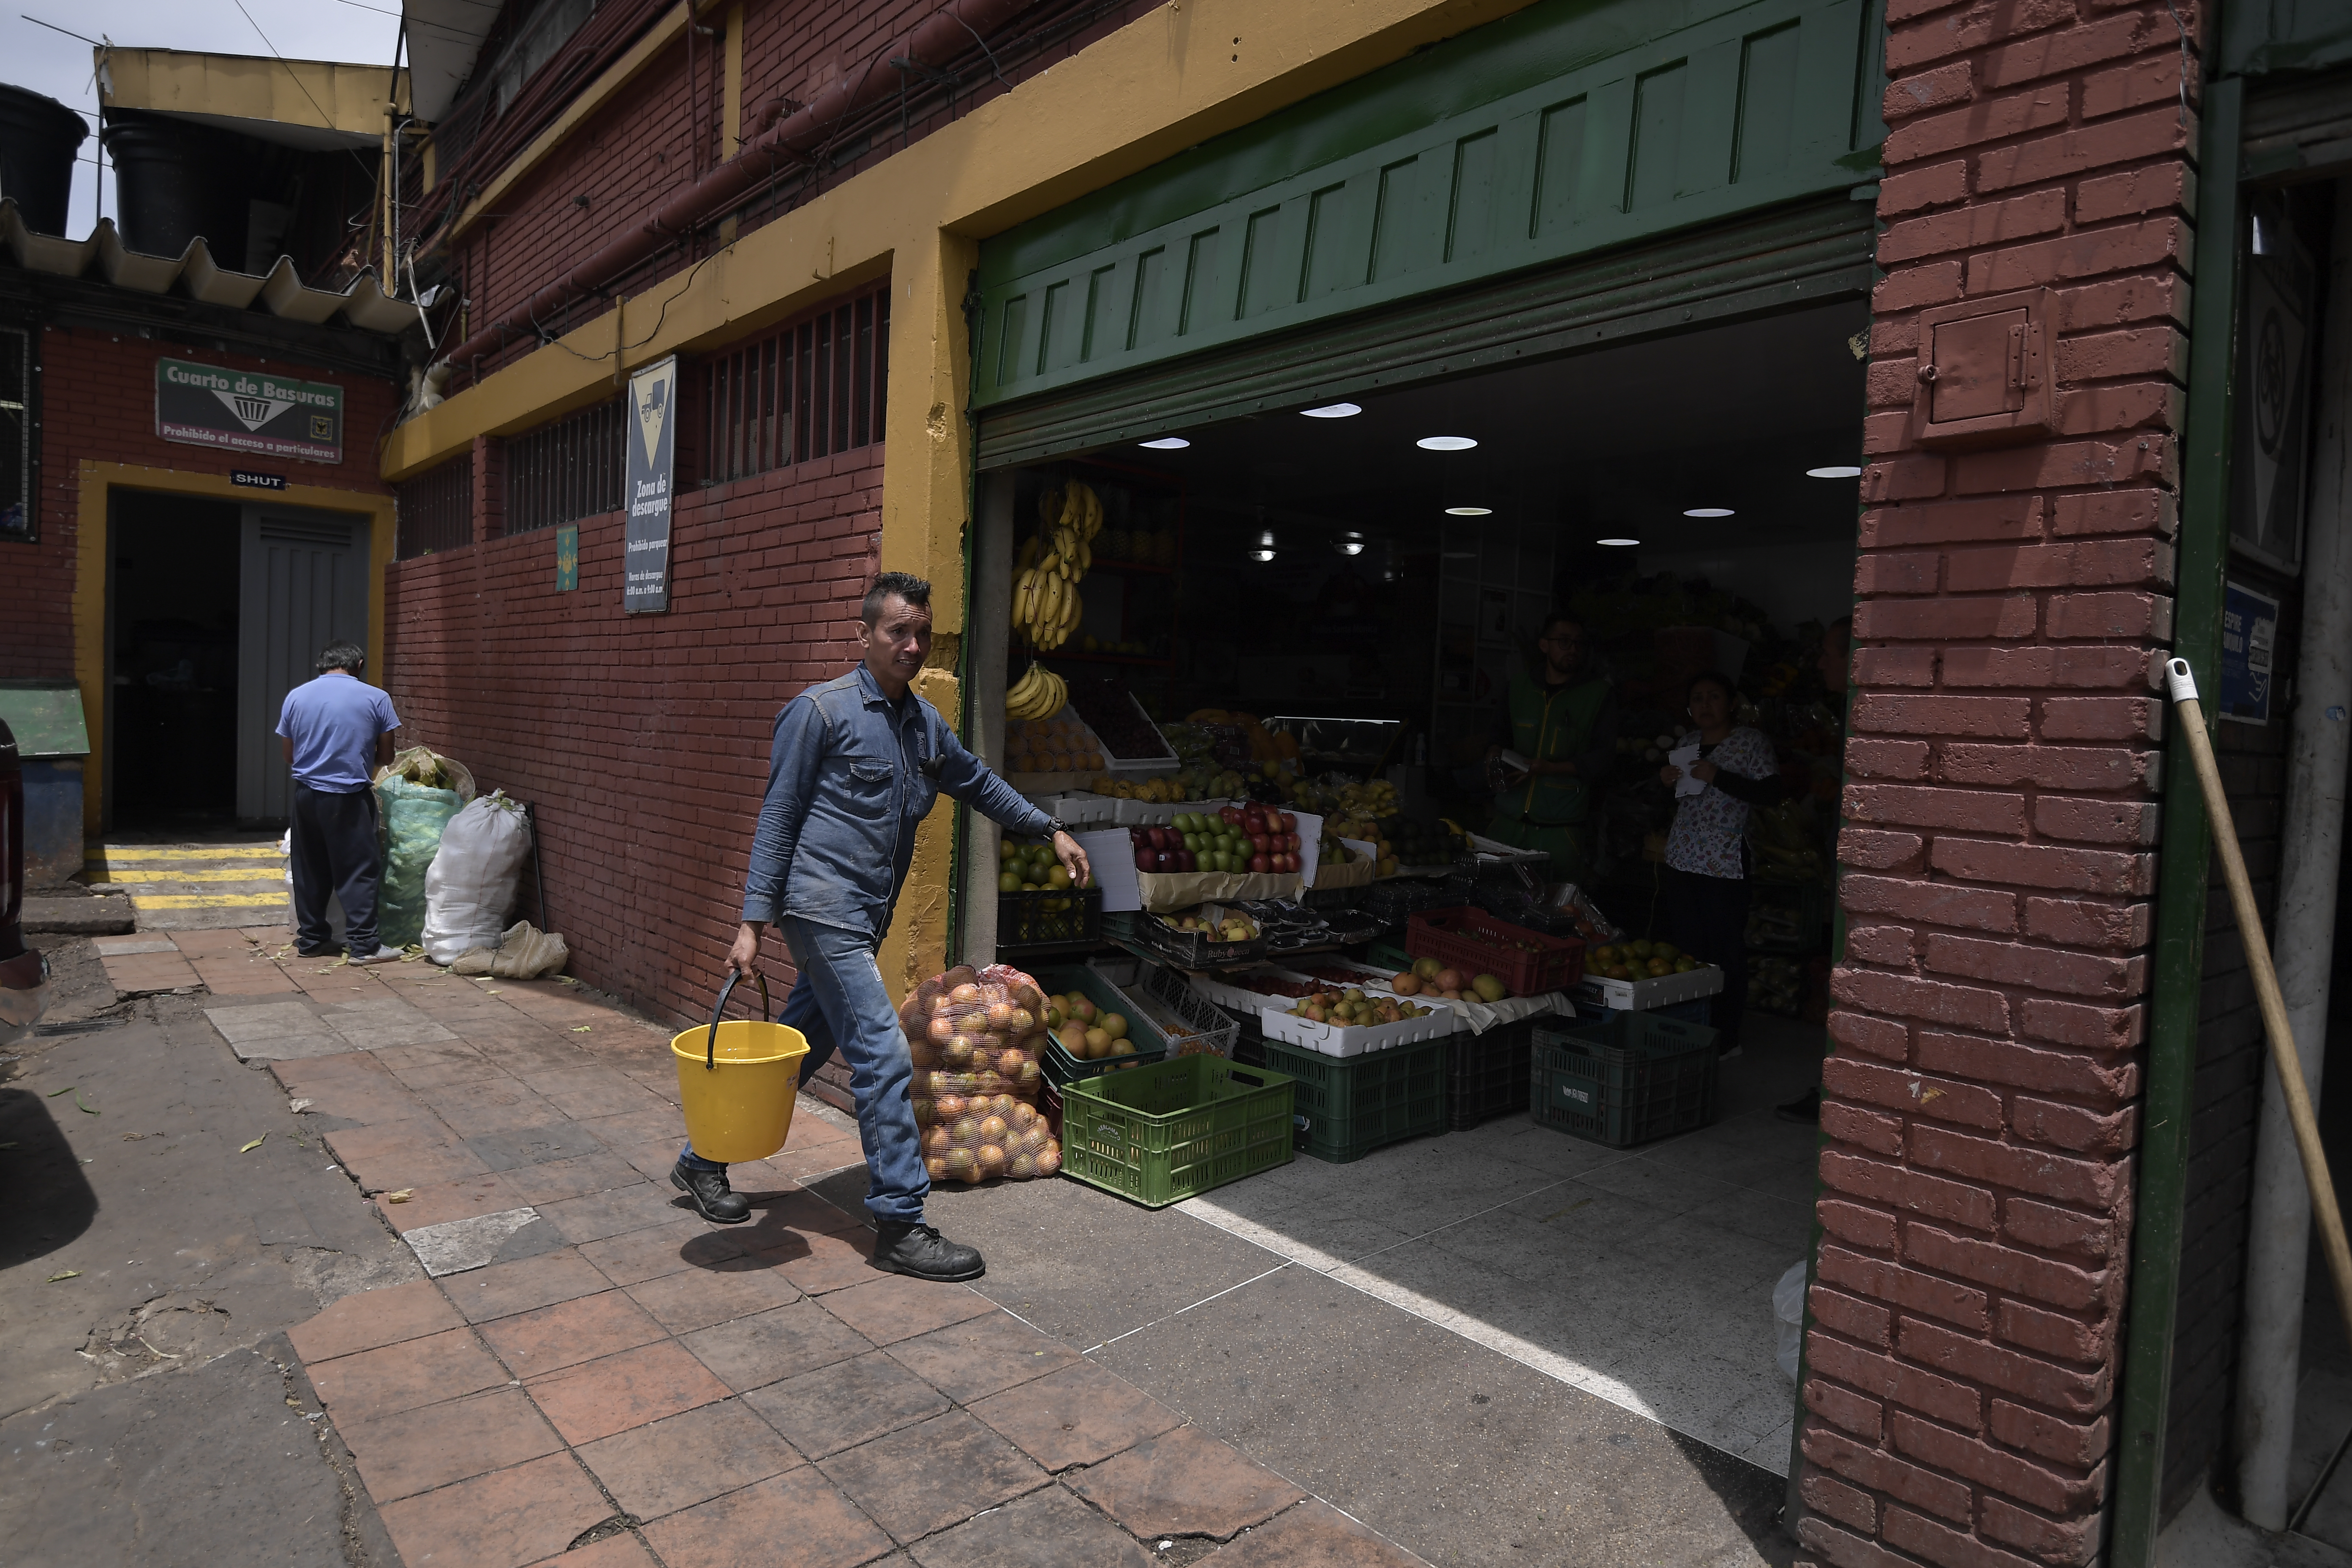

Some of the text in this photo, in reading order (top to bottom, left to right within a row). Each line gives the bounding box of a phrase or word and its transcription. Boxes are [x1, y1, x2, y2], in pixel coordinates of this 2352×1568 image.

[167, 367, 335, 407] Cuarto de Basuras
[164, 425, 216, 442] Prohibido
[219, 433, 229, 443] el
[231, 437, 264, 449] acceso
[276, 444, 335, 459] particulares
[236, 474, 282, 487] SHUT
[637, 474, 667, 498] Zona de
[632, 498, 668, 517] descargue
[628, 539, 668, 553] Prohibido parquear
[629, 569, 663, 581] Horas de descargue
